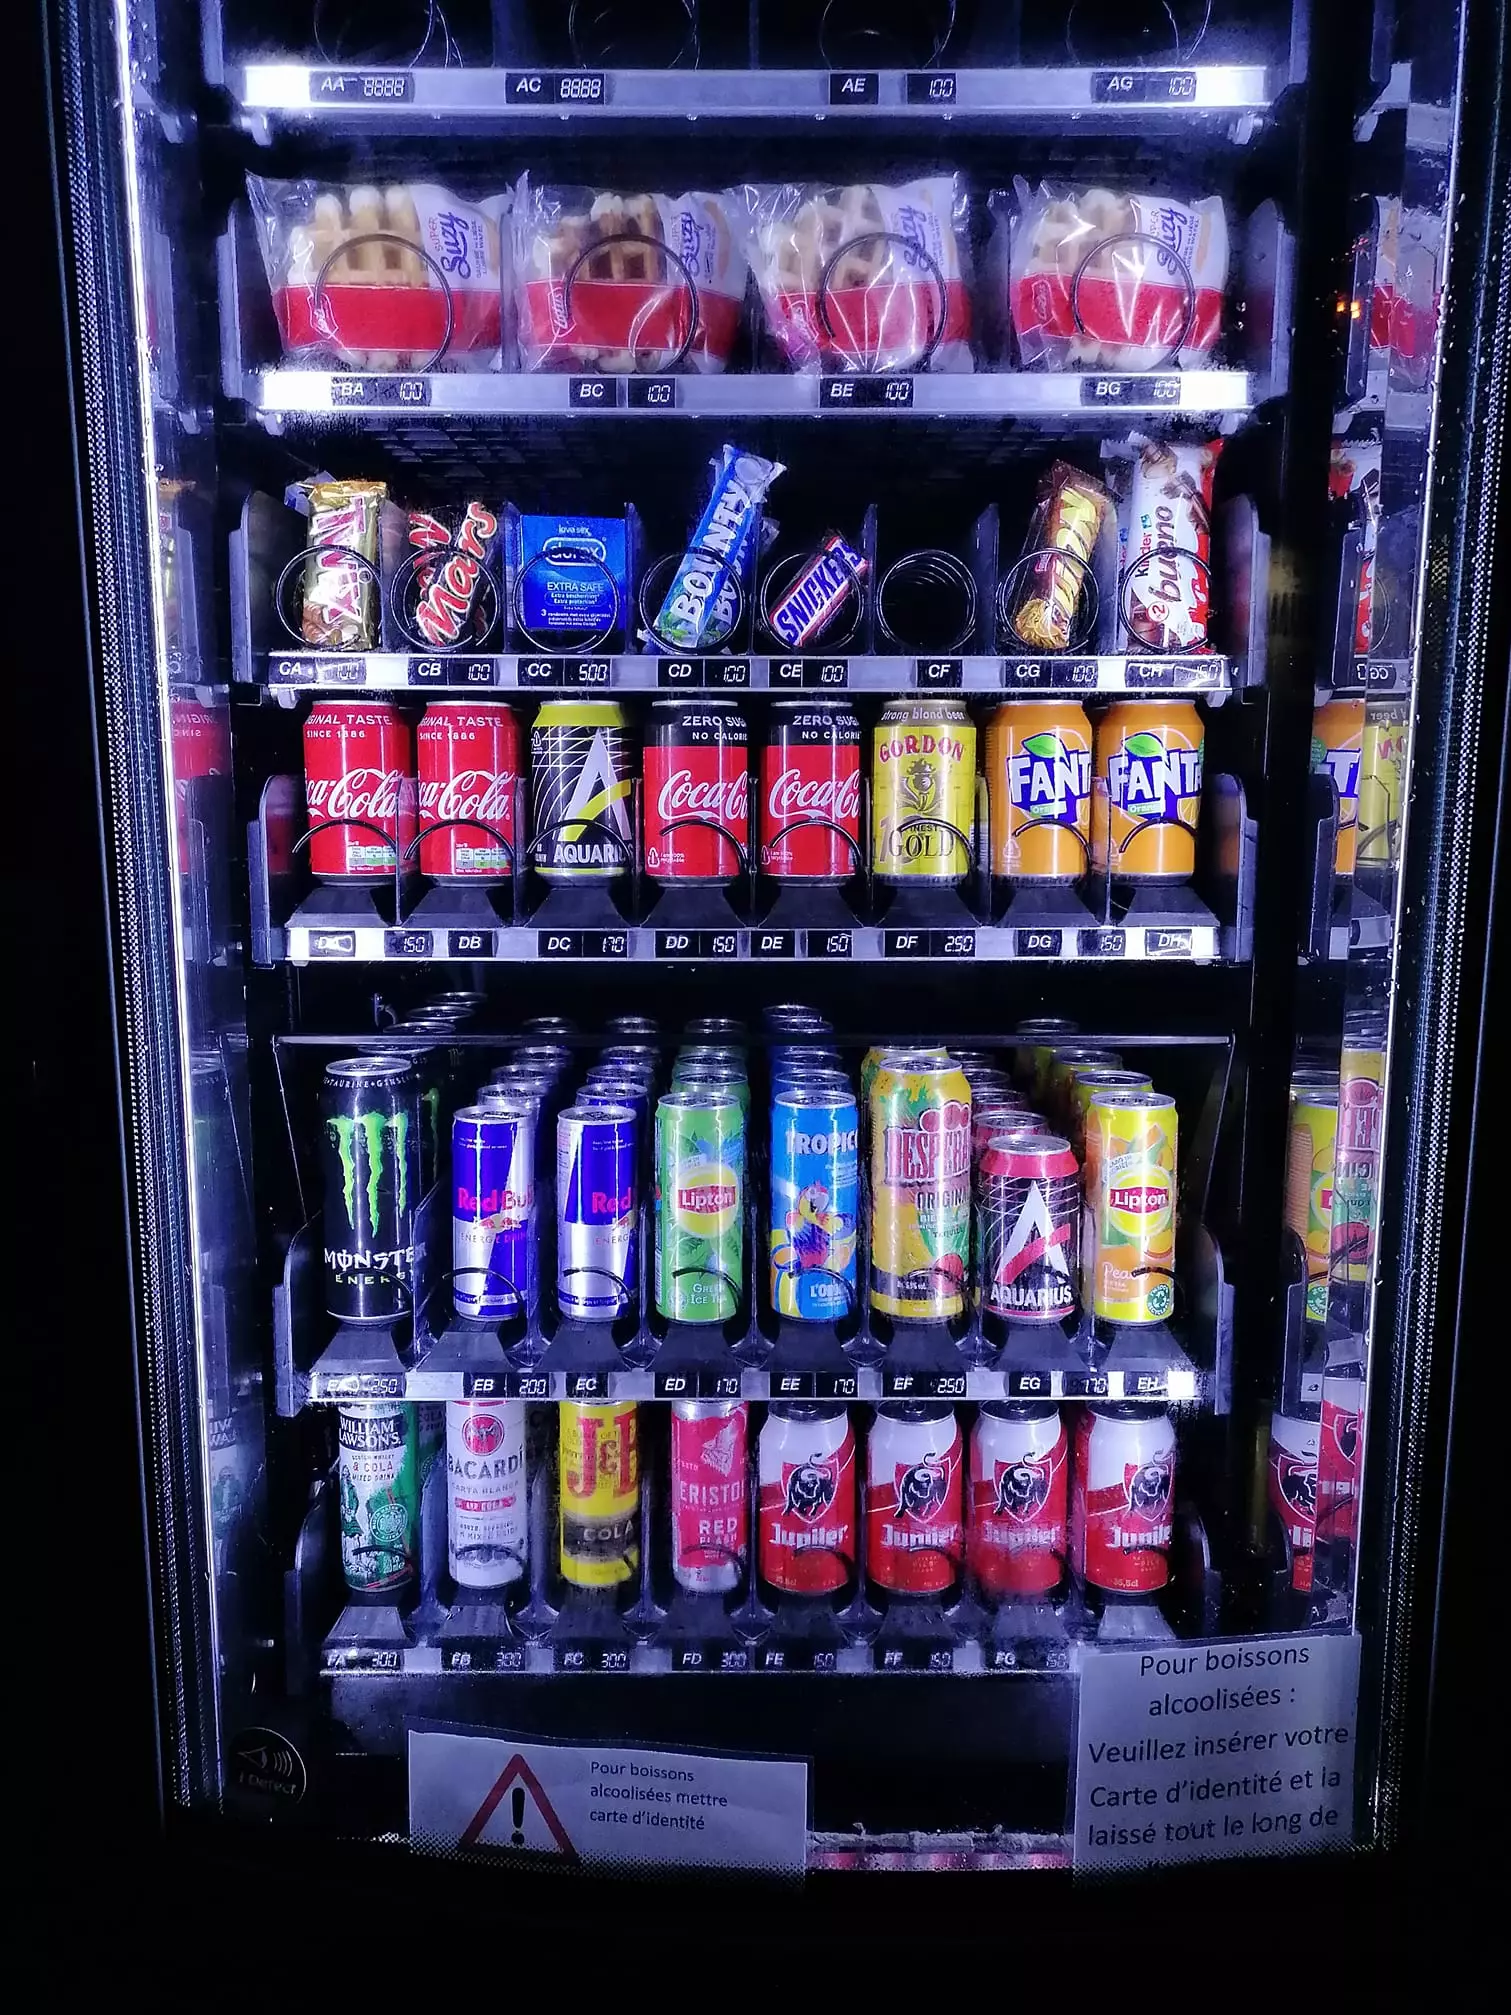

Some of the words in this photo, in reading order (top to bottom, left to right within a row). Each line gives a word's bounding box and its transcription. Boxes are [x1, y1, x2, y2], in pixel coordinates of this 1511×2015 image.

[321, 76, 345, 91] AA
[516, 77, 541, 92] AC
[842, 77, 865, 92] AE
[1107, 76, 1134, 92] AG
[439, 211, 471, 279] Suzy
[341, 382, 364, 396] BA
[580, 384, 604, 398] BC
[830, 384, 854, 398] BE
[1096, 381, 1120, 396] BG
[670, 479, 752, 622] BOUNTY
[416, 501, 497, 648] Mars
[547, 581, 579, 592] EXTRA
[580, 582, 605, 592] SAFE
[776, 542, 863, 644] SNICKERS
[279, 661, 302, 675] CA
[418, 663, 441, 677] CB
[528, 663, 552, 677] CC
[668, 664, 692, 678] CD
[779, 664, 802, 678] CE
[928, 665, 951, 678] CF
[1016, 665, 1040, 677] CG
[346, 714, 393, 725] TASTE
[456, 716, 504, 727] TASTE
[682, 715, 723, 727] ZERO
[793, 715, 833, 726] ZERO
[880, 709, 910, 723] strong
[911, 706, 944, 720] blond
[944, 708, 965, 720] beer
[306, 729, 332, 738] SINCE
[336, 730, 366, 738] 1886
[419, 732, 443, 740] SINCE
[447, 732, 476, 740] 1886
[692, 731, 709, 740] NO
[802, 731, 818, 739] NO
[879, 734, 965, 765] GORDON
[304, 767, 402, 819] ca-Cola
[417, 770, 515, 820] ca-Cola
[907, 823, 939, 833] INEST
[888, 829, 955, 858] GOLD
[458, 937, 482, 949] DB
[548, 937, 571, 950] DC
[666, 936, 689, 949] DD
[761, 936, 783, 949] DE
[896, 937, 918, 949] DF
[1028, 935, 1051, 948] DG
[457, 1187, 498, 1212] Red
[592, 1186, 632, 1214] Red
[681, 1190, 733, 1209] Lipton
[1114, 1191, 1166, 1209] Lipton
[990, 1285, 1072, 1307] AQUARIUS
[474, 1379, 494, 1391] EB
[576, 1378, 597, 1391] EC
[665, 1378, 686, 1391] ED
[780, 1378, 801, 1391] EE
[893, 1377, 913, 1390] EF
[1020, 1377, 1041, 1390] EG
[1137, 1377, 1158, 1390] EH
[339, 1415, 394, 1435] WILLIAM
[364, 1460, 394, 1472] COLA
[583, 1520, 634, 1542] COLA
[699, 1516, 738, 1535] RED
[682, 1653, 702, 1665] FD
[765, 1652, 784, 1665] FE
[1140, 1655, 1199, 1677] Pour
[1205, 1647, 1310, 1672] boissons
[1149, 1685, 1282, 1716] alcoolisées
[1088, 1738, 1186, 1763] Veuillez
[1194, 1730, 1277, 1757] insérer
[1285, 1726, 1350, 1746] votre
[590, 1761, 627, 1776] Pour
[630, 1762, 695, 1783] boissons
[1090, 1786, 1158, 1808] Carte
[1166, 1770, 1283, 1804] d'identité
[1290, 1771, 1313, 1790] et
[1321, 1766, 1341, 1788] la
[590, 1784, 672, 1804] alcoolisées
[676, 1790, 728, 1808] mettre
[590, 1808, 628, 1825] carte
[632, 1810, 706, 1831] d'identité
[1088, 1822, 1157, 1846] laissé
[1164, 1820, 1216, 1842] tout
[1223, 1815, 1245, 1836] le
[1252, 1811, 1302, 1835] long
[1309, 1805, 1339, 1826] de
